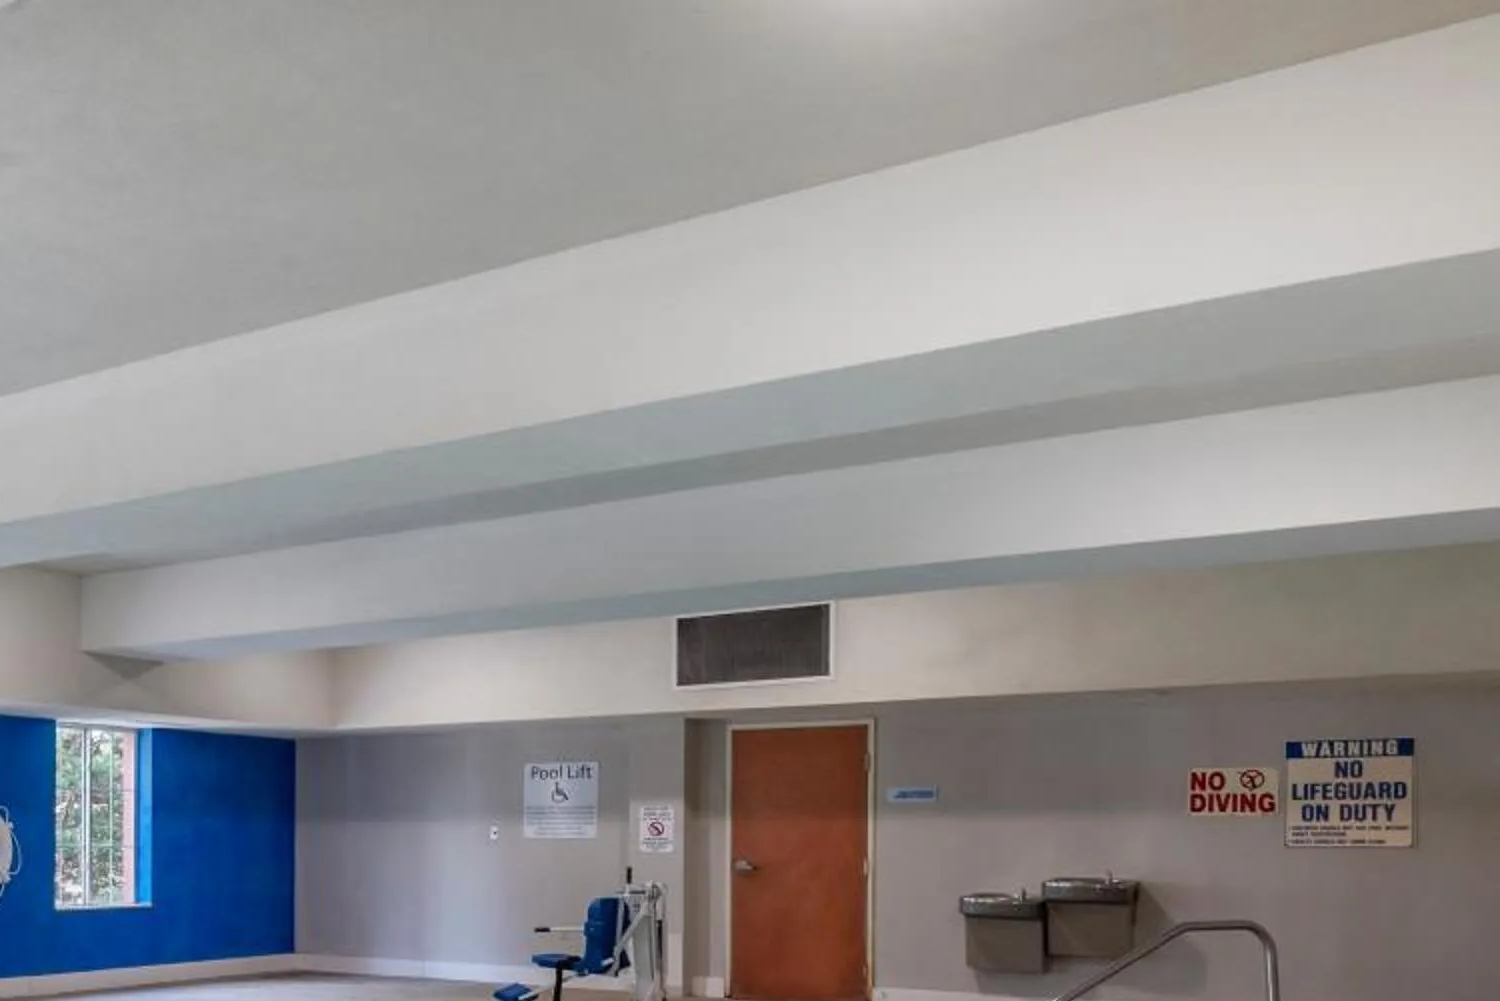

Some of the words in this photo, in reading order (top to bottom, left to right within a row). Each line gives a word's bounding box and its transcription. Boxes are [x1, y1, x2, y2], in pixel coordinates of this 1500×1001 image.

[1301, 739, 1399, 758] WARNING
[531, 765, 563, 781] Pool
[567, 764, 592, 780] Lift
[1334, 760, 1364, 779] NO
[1190, 771, 1226, 791] NO
[1291, 781, 1408, 801] LIFEGUARD
[1189, 793, 1276, 813] DIVING
[1301, 804, 1330, 823] ON
[1339, 803, 1397, 823] DUTY
